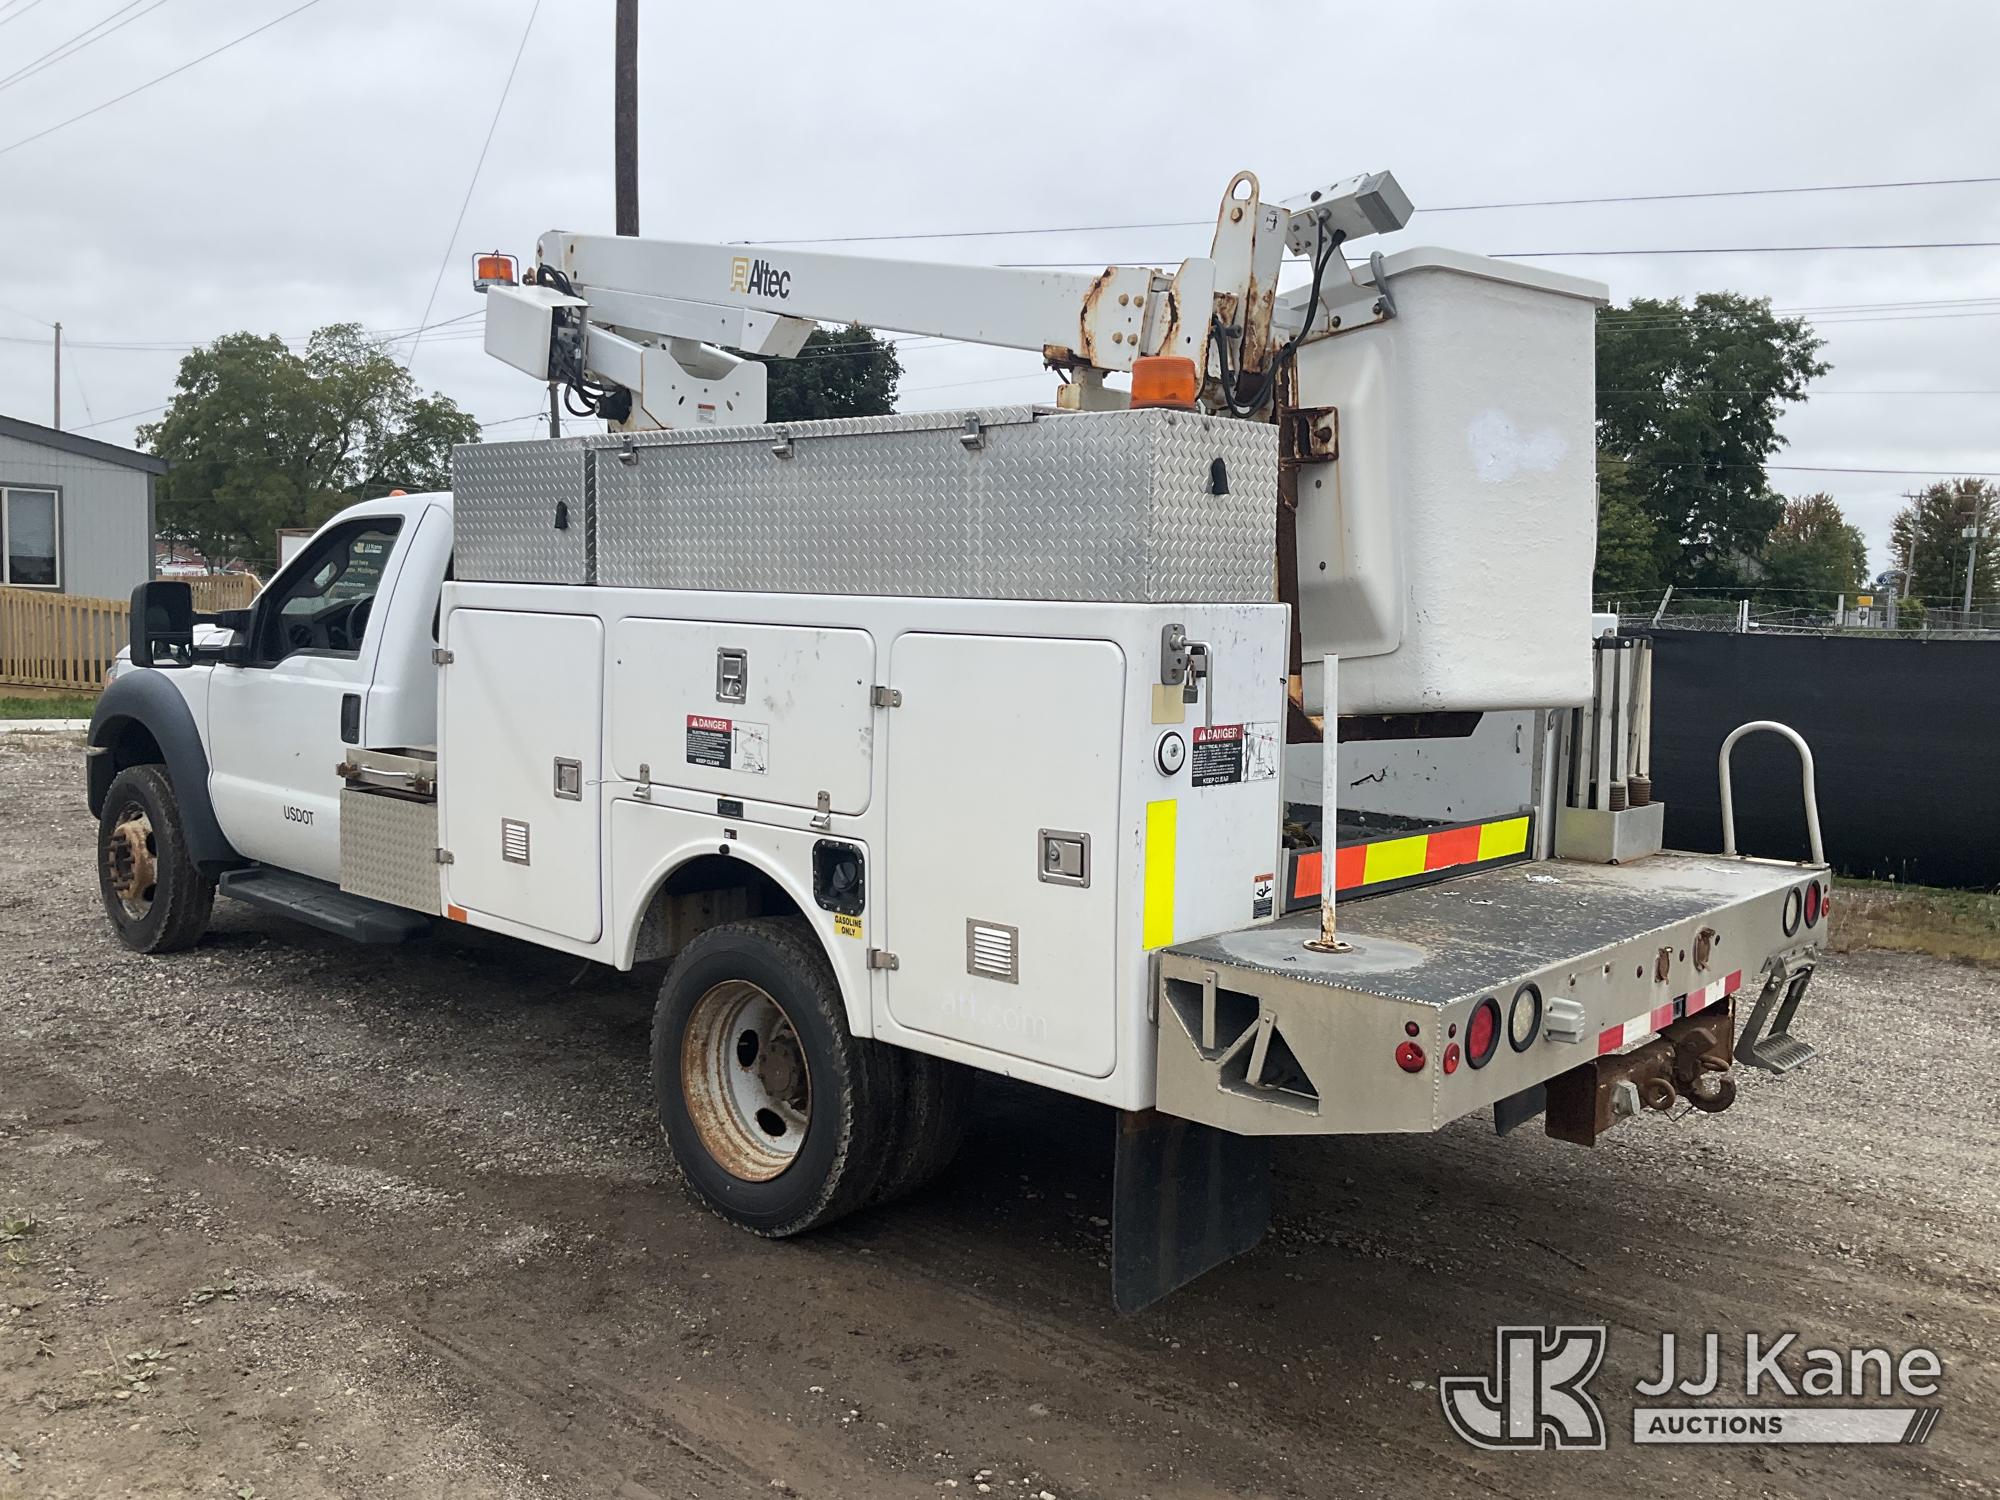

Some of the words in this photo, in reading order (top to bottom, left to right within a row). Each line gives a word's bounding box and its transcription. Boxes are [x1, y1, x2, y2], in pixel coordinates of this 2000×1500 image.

[747, 259, 791, 299] Altec
[699, 718, 728, 730] DANGER
[1207, 727, 1238, 740] DANGER
[1202, 776, 1215, 784] KEEP
[283, 804, 314, 827] USDOT
[834, 914, 862, 928] GASOLINE
[841, 926, 856, 937] ONLY
